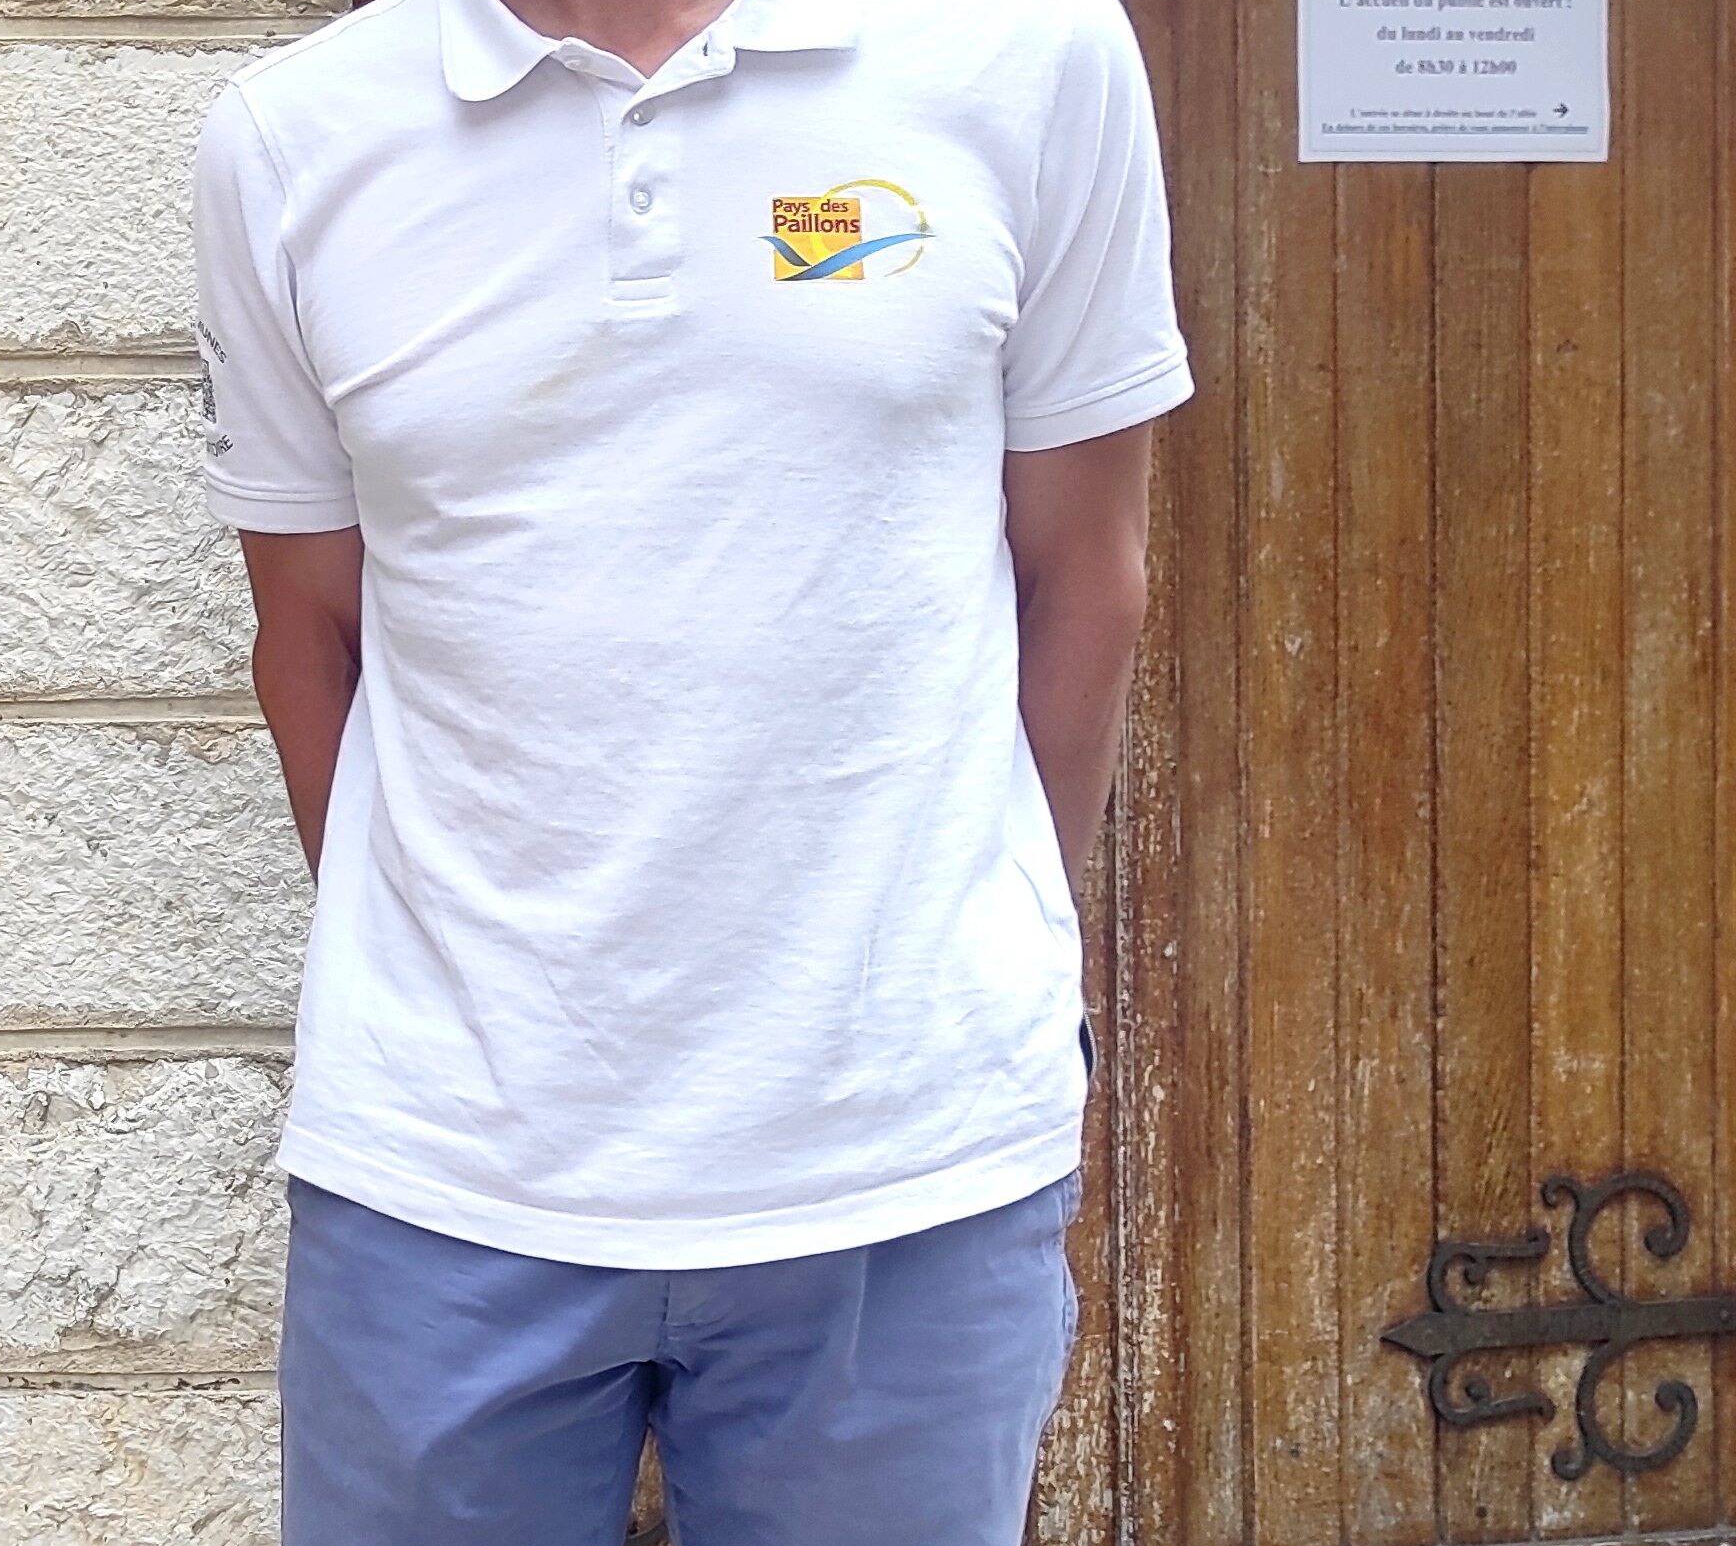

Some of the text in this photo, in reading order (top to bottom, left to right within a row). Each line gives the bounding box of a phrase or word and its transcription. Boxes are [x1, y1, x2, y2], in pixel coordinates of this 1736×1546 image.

[772, 199, 849, 216] Pays des
[772, 213, 861, 233] Paillons
